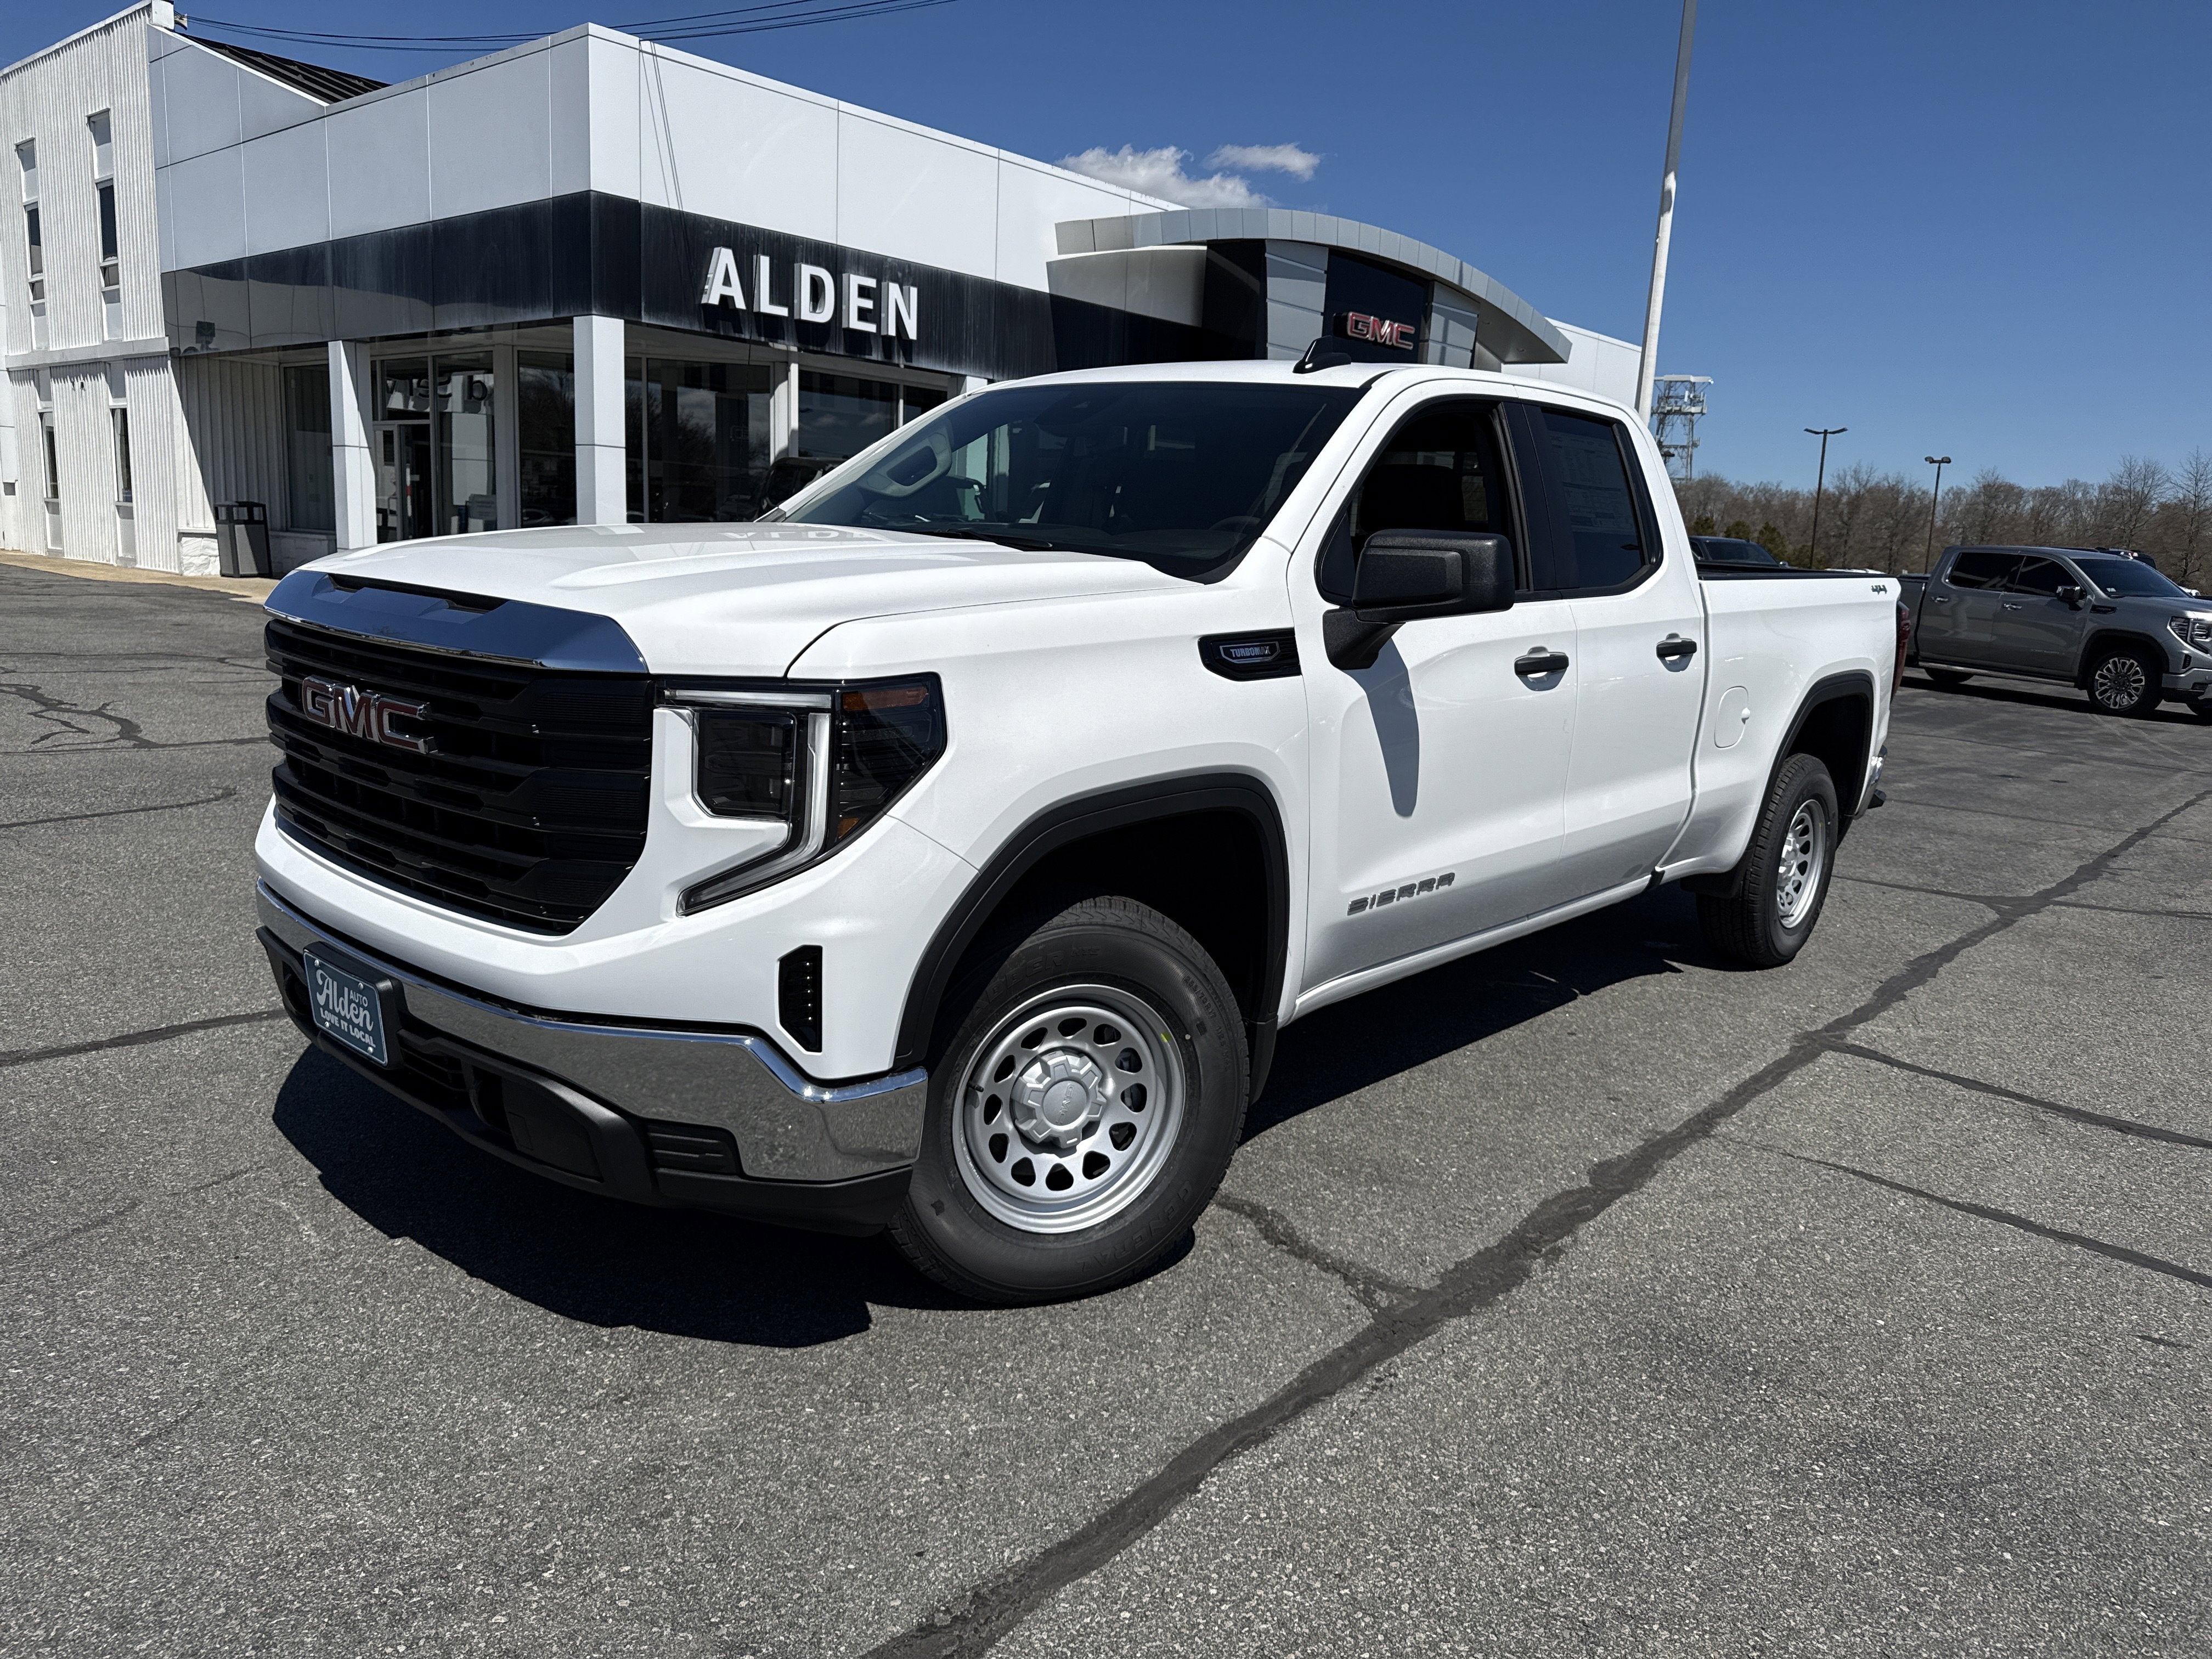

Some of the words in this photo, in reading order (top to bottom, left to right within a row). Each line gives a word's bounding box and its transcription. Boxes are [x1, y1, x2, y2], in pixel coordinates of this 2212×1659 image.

[701, 246, 917, 340] ALDEN
[1347, 312, 1415, 350] GMC
[1230, 646, 1271, 658] TURBOMAX
[302, 675, 432, 754] GMC
[1347, 872, 1455, 916] SIERRA
[316, 969, 374, 1031] Alden
[349, 990, 368, 1007] AUTO
[320, 1007, 340, 1027] LOVE
[341, 1019, 348, 1032] IT
[349, 1024, 376, 1048] LOCAL
